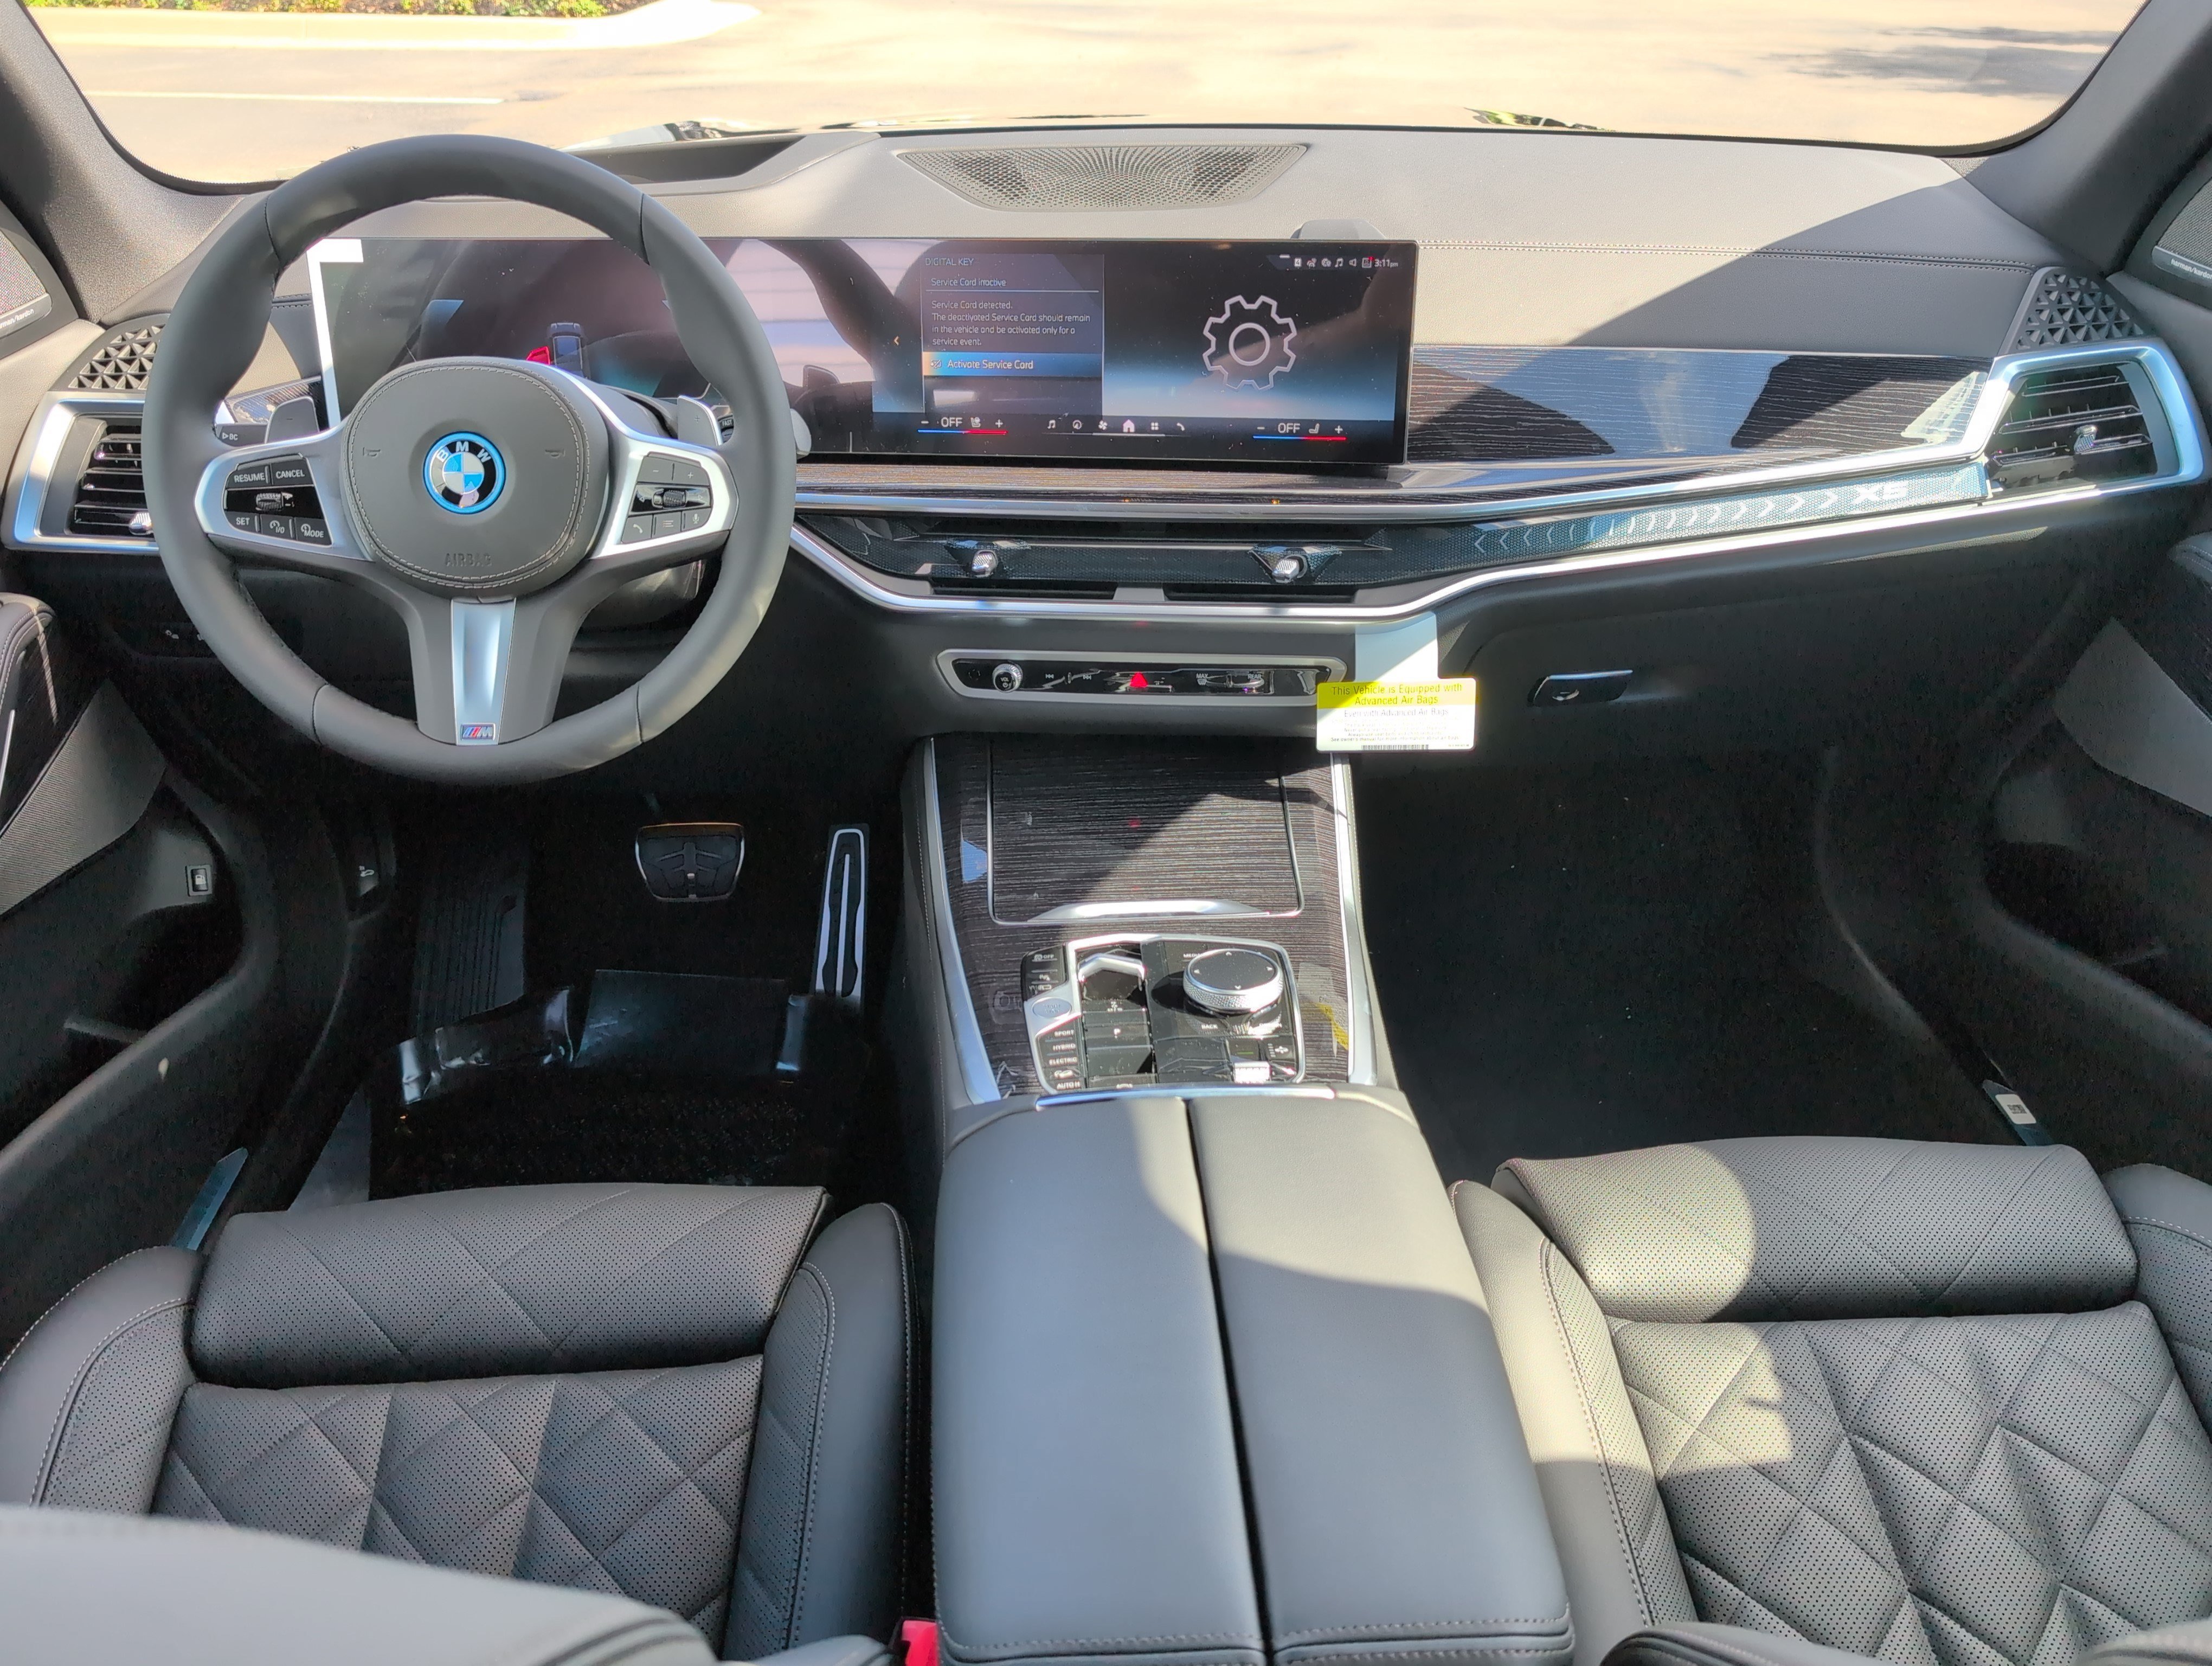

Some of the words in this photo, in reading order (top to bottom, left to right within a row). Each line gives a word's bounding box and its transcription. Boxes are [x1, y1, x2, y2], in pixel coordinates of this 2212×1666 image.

[925, 257, 957, 266] DIGITAL
[959, 258, 974, 266] KEY
[931, 278, 959, 286] Service
[960, 278, 976, 286] Card
[978, 278, 1007, 286] inactive
[932, 300, 959, 309] Service
[960, 300, 978, 309] Card
[979, 300, 1013, 310] detected.
[932, 313, 947, 322] The
[948, 313, 990, 322] deactivated
[992, 313, 1019, 322] Service
[1020, 313, 1037, 322] Card
[1038, 313, 1064, 323] should
[1065, 314, 1091, 323] remain
[932, 325, 939, 334] in
[940, 325, 953, 334] the
[954, 325, 979, 334] vehicle
[981, 326, 995, 334] and
[996, 326, 1006, 335] be
[1007, 326, 1040, 335] activated
[1042, 326, 1058, 336] only
[1059, 326, 1069, 335] for
[932, 337, 958, 346] service
[947, 360, 980, 369] Activate
[982, 360, 1013, 369] Service
[1014, 361, 1034, 369] Card
[941, 417, 962, 427] OFF
[1278, 424, 1301, 433] OFF
[436, 440, 492, 464] BMW
[234, 472, 266, 483] RESUME
[275, 469, 305, 479] CANCEL
[236, 517, 250, 526] SET
[304, 530, 324, 538] MODE
[445, 553, 493, 567] AIRBAG
[1332, 686, 1350, 696] This
[1354, 684, 1385, 695] Vehicle
[1388, 686, 1396, 694] is
[1399, 683, 1441, 695] Equipped
[1444, 682, 1462, 692] with
[1355, 696, 1398, 706] Advanced
[1401, 695, 1413, 704] Air
[1417, 695, 1439, 706] Bags
[1381, 709, 1416, 717] Advanced
[1049, 1057, 1078, 1065] ELECTRIC
[1057, 1081, 1075, 1090] AUTO
